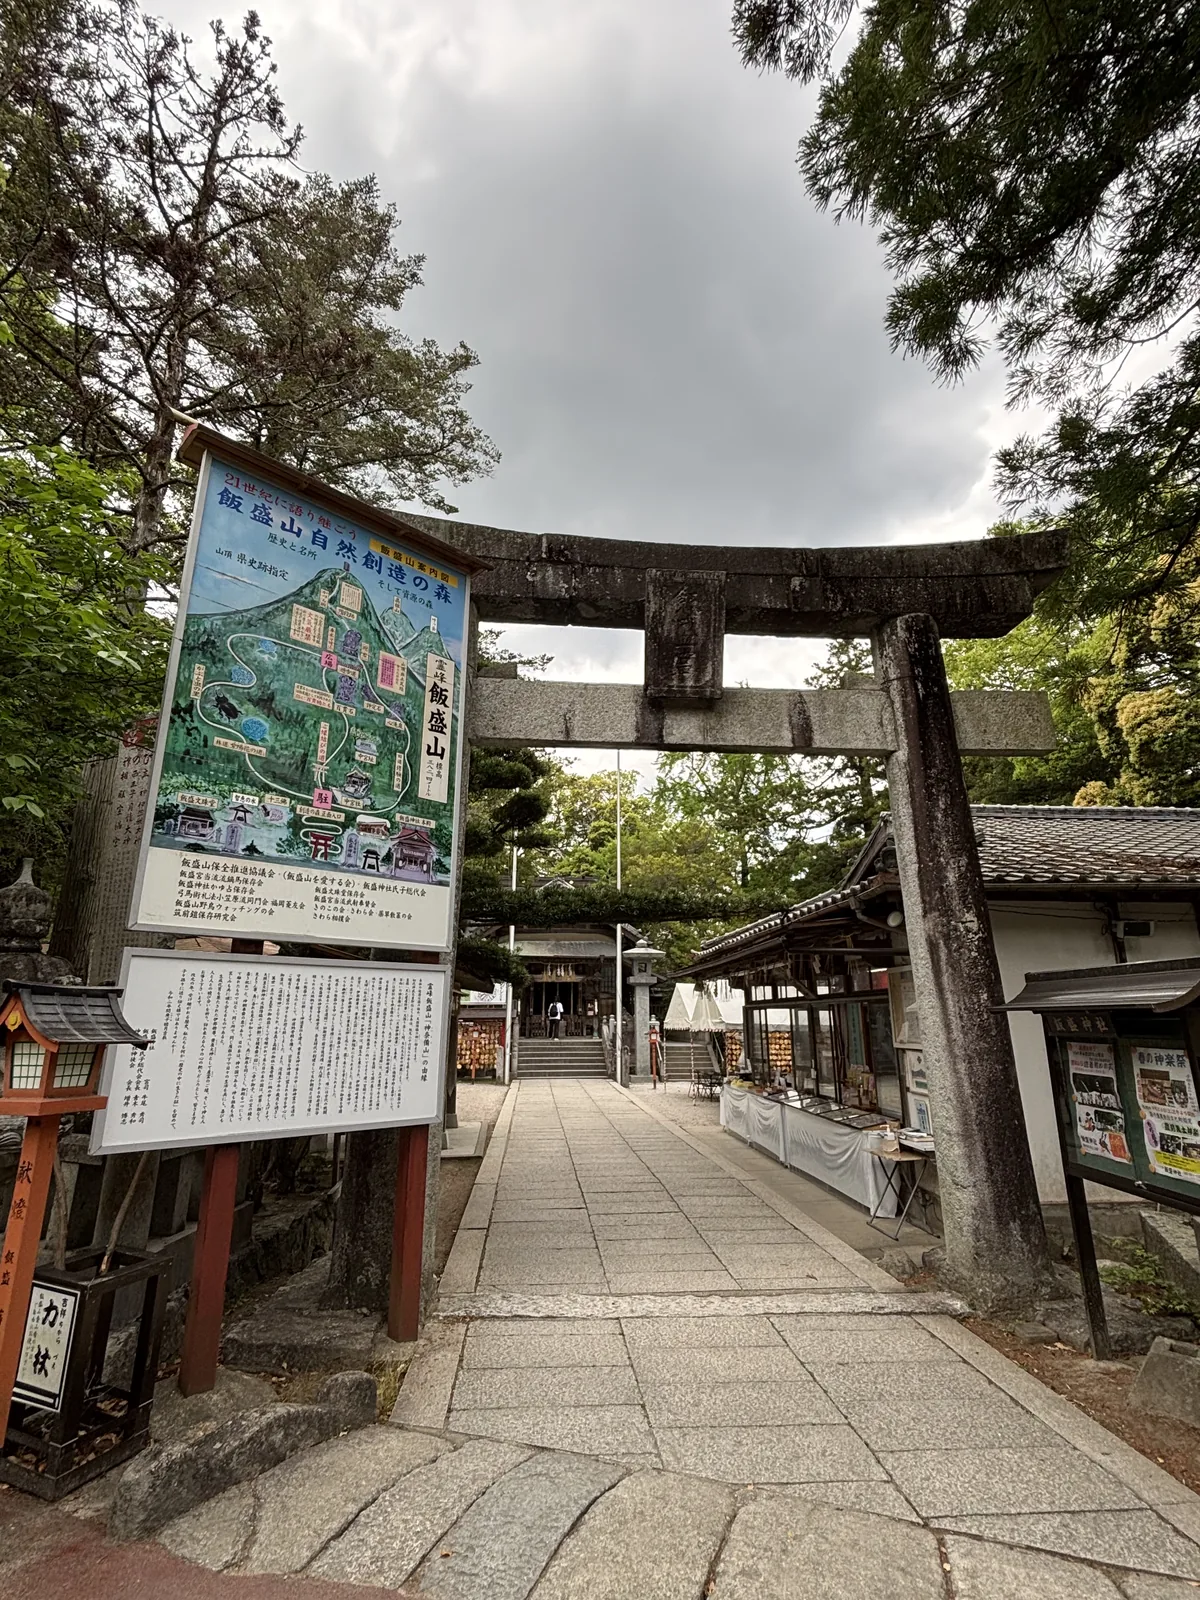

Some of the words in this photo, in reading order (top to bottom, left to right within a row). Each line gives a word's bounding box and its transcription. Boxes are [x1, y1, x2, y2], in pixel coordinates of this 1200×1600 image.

[224, 472, 356, 541] 21世紀に語り継ごう
[215, 547, 233, 559] 山頂
[217, 486, 453, 605] 飯盛山自然創造の森
[267, 532, 318, 561] 歴史と名所
[380, 544, 450, 583] 飯盛山案内図
[324, 653, 333, 668] 広場
[433, 659, 448, 683] 霊峰
[426, 681, 450, 760] 飯盛山
[316, 792, 328, 804] 駐
